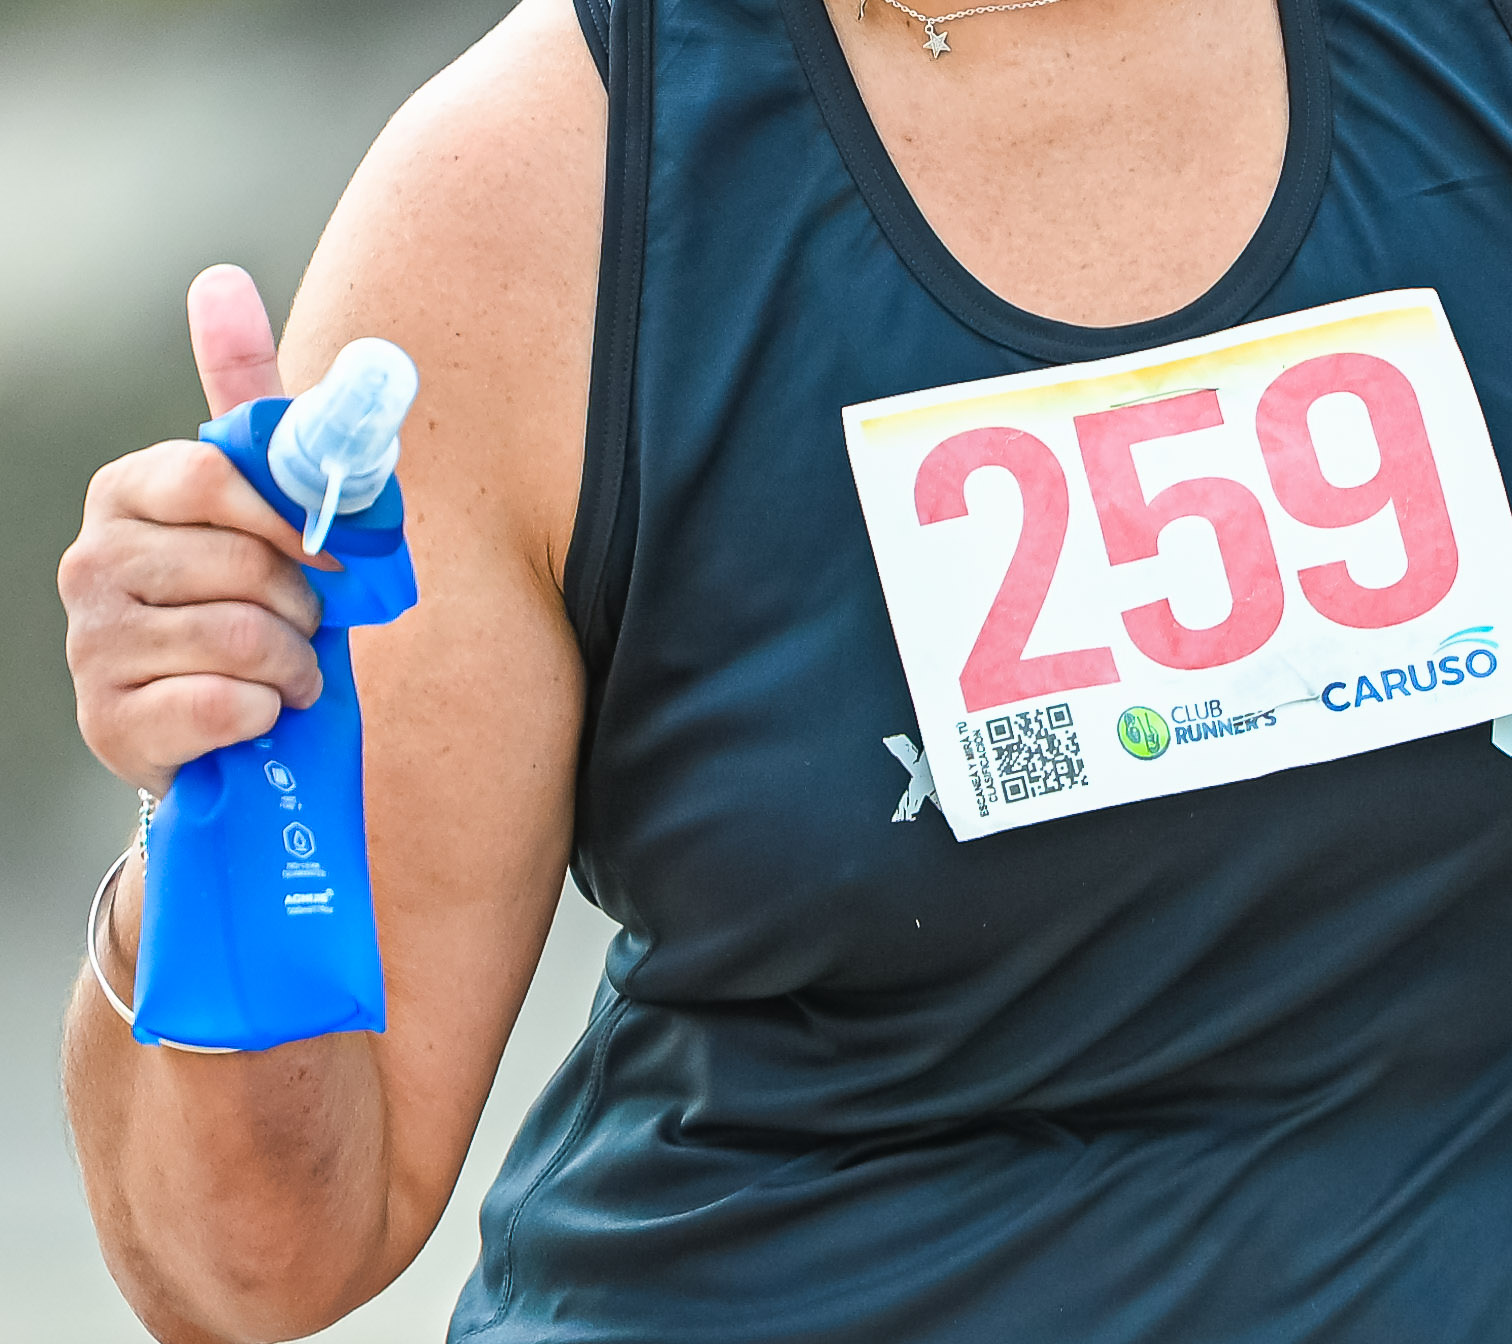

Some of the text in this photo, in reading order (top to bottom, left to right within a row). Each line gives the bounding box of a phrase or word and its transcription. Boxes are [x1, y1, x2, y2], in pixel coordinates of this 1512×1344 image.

[913, 352, 1458, 714] 259
[1171, 699, 1223, 724] CLUB
[1321, 649, 1498, 712] CARUSO
